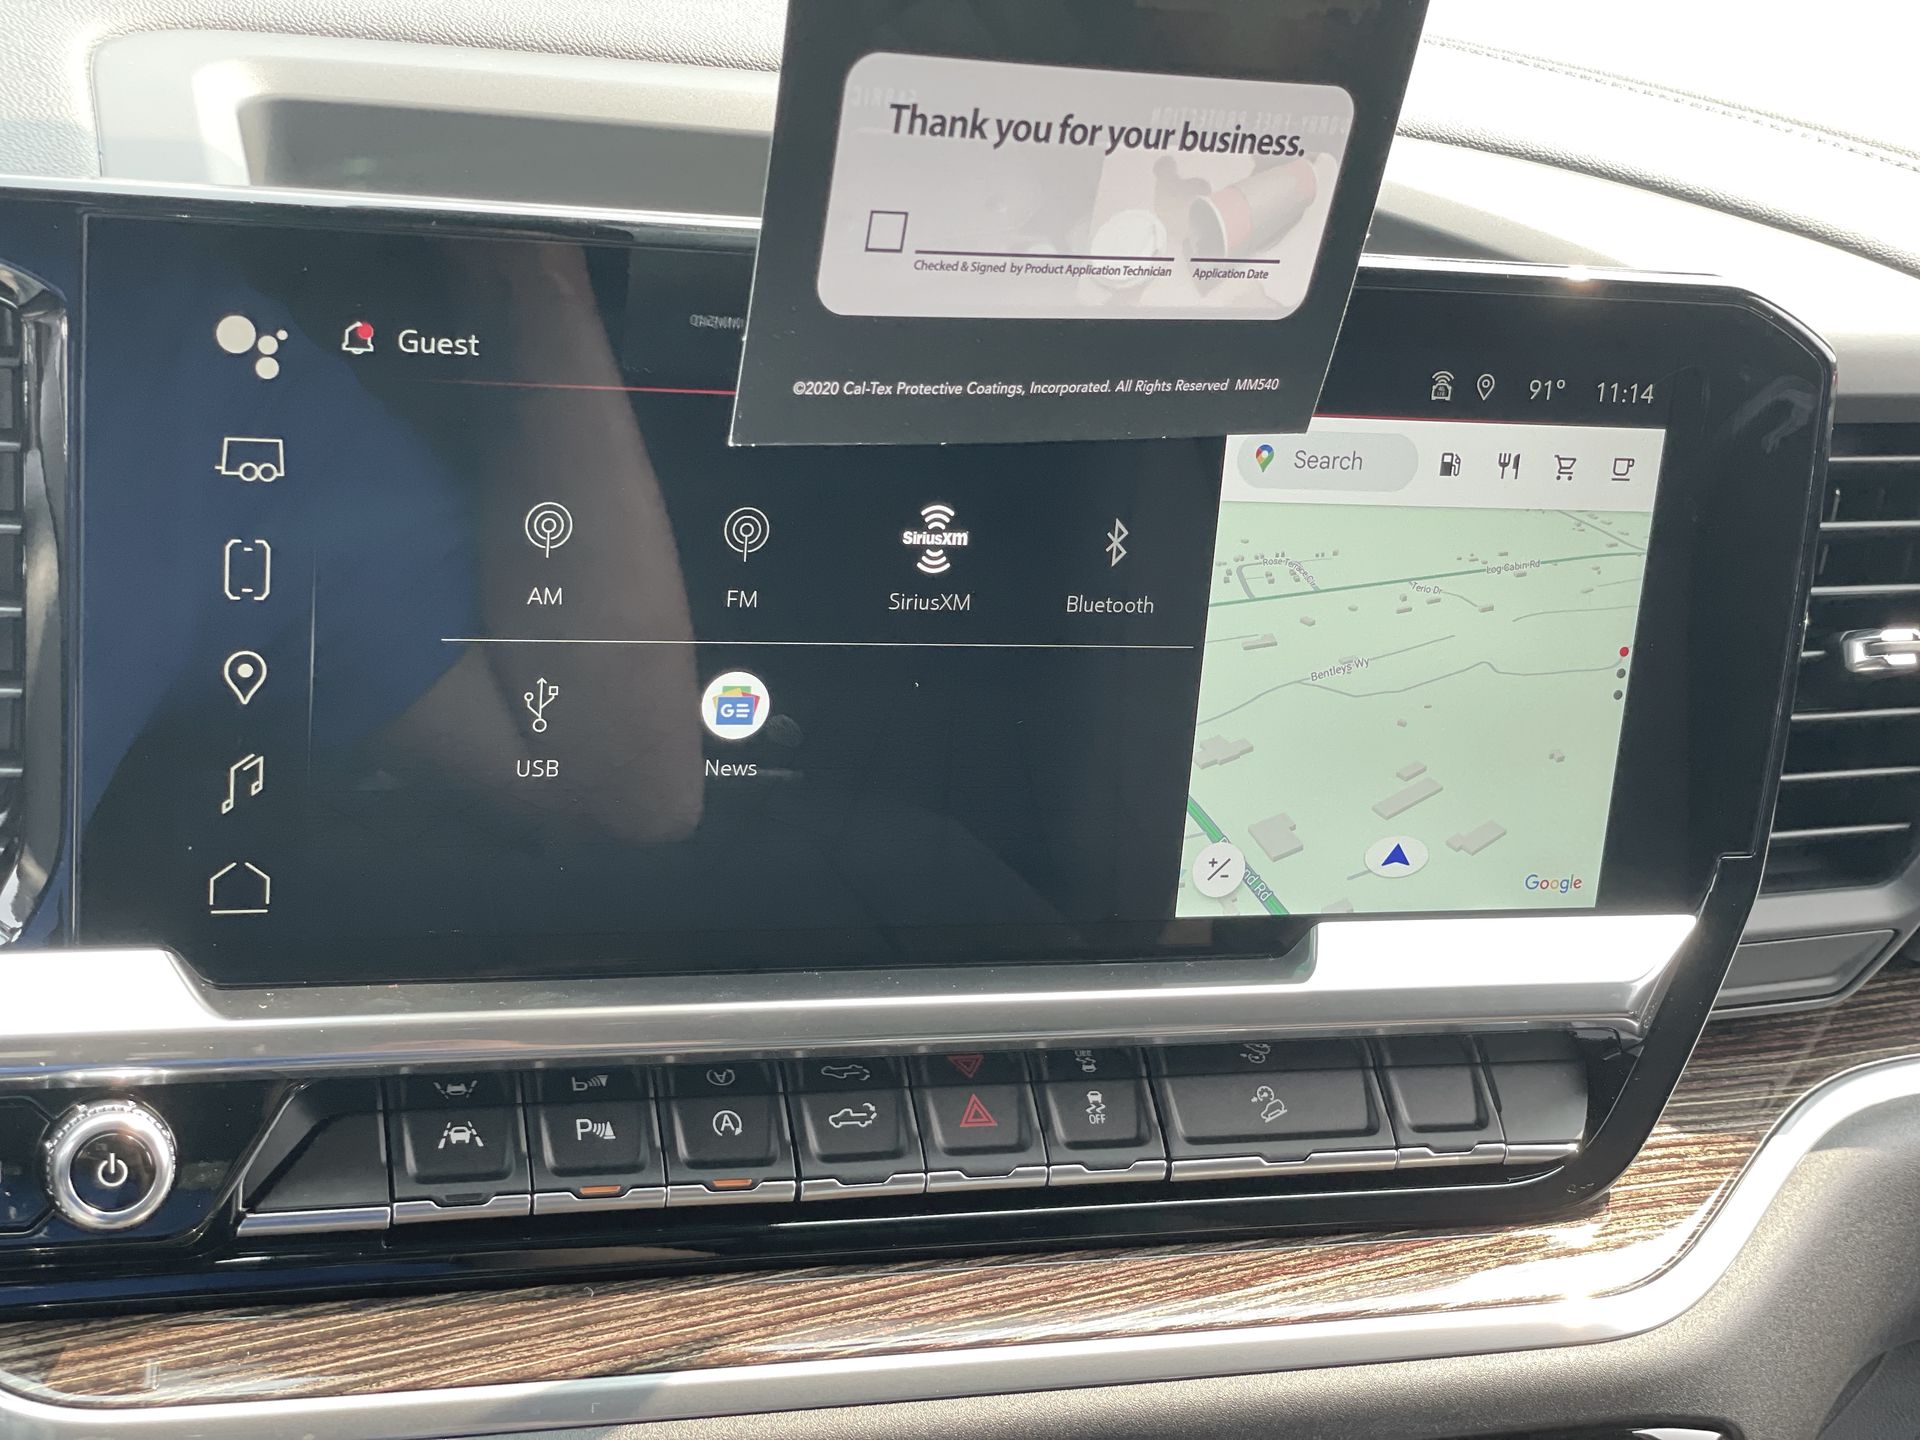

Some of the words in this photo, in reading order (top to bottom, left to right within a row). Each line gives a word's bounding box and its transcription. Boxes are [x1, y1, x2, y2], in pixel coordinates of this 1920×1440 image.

[890, 103, 989, 140] Thank
[993, 117, 1053, 149] you
[1058, 113, 1103, 146] for
[1105, 125, 1175, 156] your
[1179, 120, 1305, 157] business.
[913, 259, 959, 272] Checked
[960, 261, 969, 272] &
[970, 261, 1007, 275] Signed
[1010, 263, 1022, 276] by
[1024, 264, 1064, 275] Product
[1065, 264, 1121, 278] Application
[1122, 265, 1172, 277] Technician
[1192, 268, 1246, 281] Application
[1247, 269, 1269, 280] Date
[397, 329, 480, 358] Guest
[793, 381, 839, 396] ©2020
[843, 381, 893, 395] Cal-Tex
[896, 381, 963, 395] Protective
[966, 381, 1026, 398] Coatings,
[1029, 380, 1111, 397] Incorporated.
[1115, 379, 1133, 393] All
[1135, 379, 1172, 395] Rights
[1174, 378, 1230, 392] Reserved
[1234, 378, 1280, 391] MM540
[1597, 382, 1654, 405] 11:14
[1294, 449, 1363, 472] Search
[1262, 558, 1283, 567] Rose
[1486, 565, 1502, 575] Log
[1503, 562, 1529, 573] Cabin
[1529, 559, 1541, 569] Rd
[526, 587, 564, 606] AM
[1411, 581, 1432, 594] Terio
[726, 590, 758, 609] FM
[888, 592, 971, 611] SiriusXM
[1065, 595, 1155, 615] Bluetooth
[1310, 663, 1353, 682] Bentleys
[1353, 657, 1370, 669] Wy
[516, 759, 560, 777] USB
[704, 759, 758, 777] News
[1253, 881, 1273, 902] Rd
[1524, 873, 1583, 893] Google
[1088, 1113, 1106, 1125] OFF
